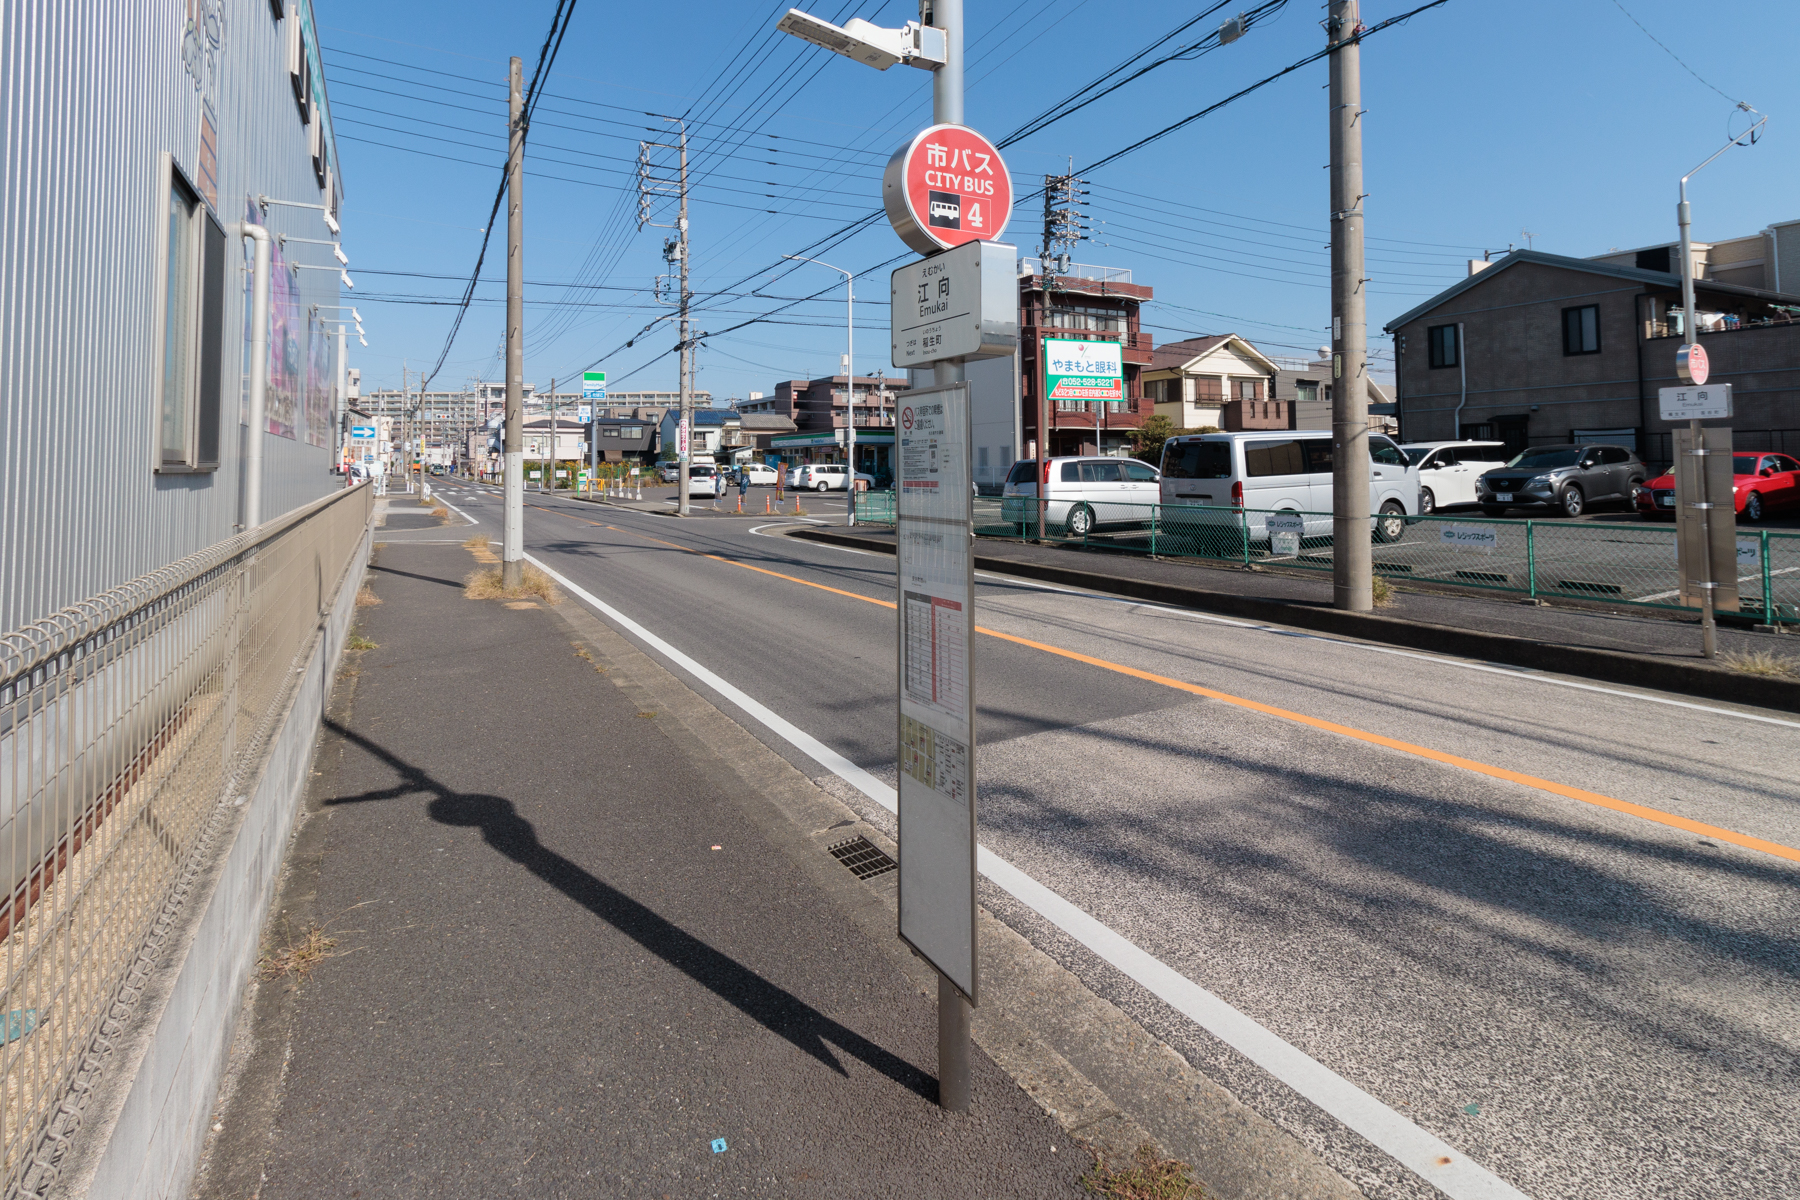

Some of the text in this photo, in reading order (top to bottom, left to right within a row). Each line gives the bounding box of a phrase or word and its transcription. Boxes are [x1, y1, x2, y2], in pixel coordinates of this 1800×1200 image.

[926, 143, 993, 176] 市バス
[925, 170, 994, 196] CITY BUS
[967, 203, 983, 228] 4
[922, 263, 945, 278] えむかい
[918, 276, 950, 304] 江向
[920, 298, 949, 318] Emukai
[1052, 359, 1117, 374] やまもと眼科
[1690, 358, 1706, 369] 市バス
[1676, 391, 1708, 401] 江向
[1276, 521, 1303, 529] レジックスポーツ
[1457, 531, 1495, 542] レジックスポーツ
